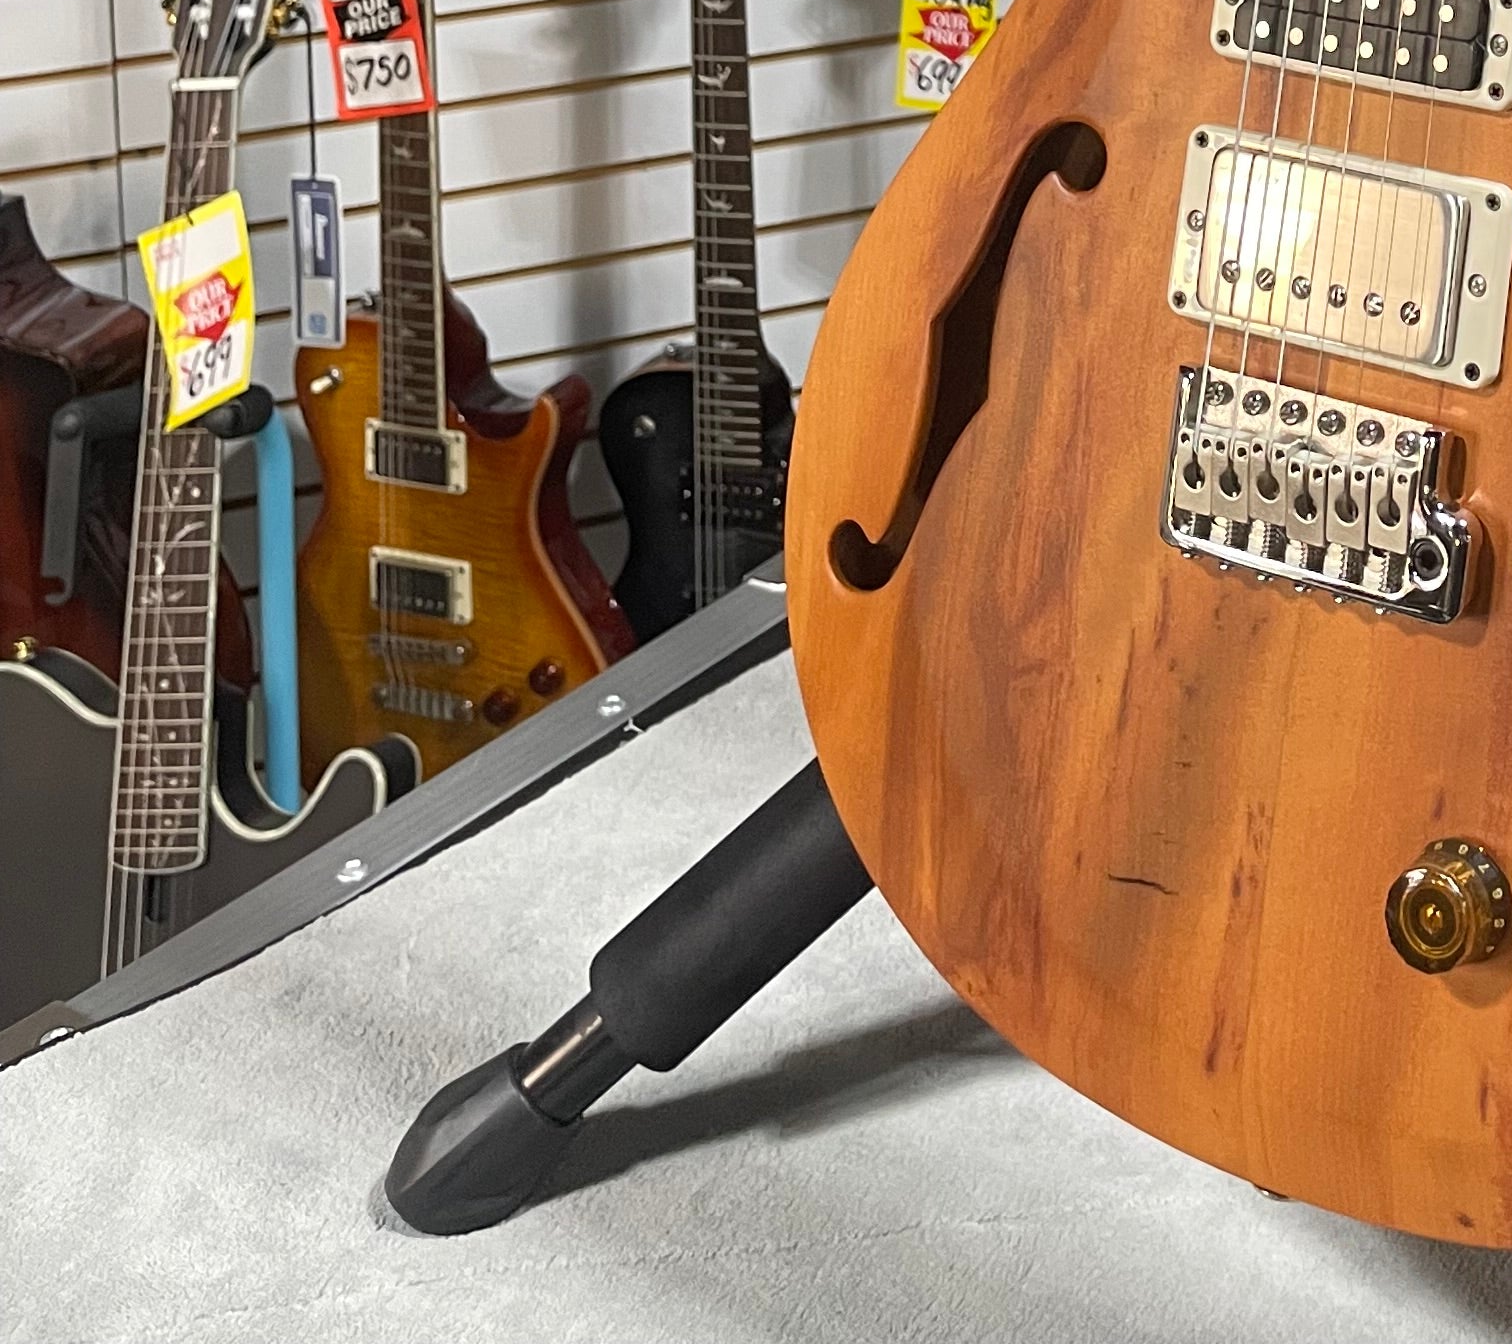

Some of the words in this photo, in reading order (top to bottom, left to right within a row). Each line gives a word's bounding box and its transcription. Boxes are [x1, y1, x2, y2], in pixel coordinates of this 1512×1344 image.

[344, 5, 402, 39] PRICE
[929, 10, 969, 30] OUR
[923, 25, 975, 48] PRICE
[344, 53, 412, 96] $750
[188, 277, 226, 308] OUR
